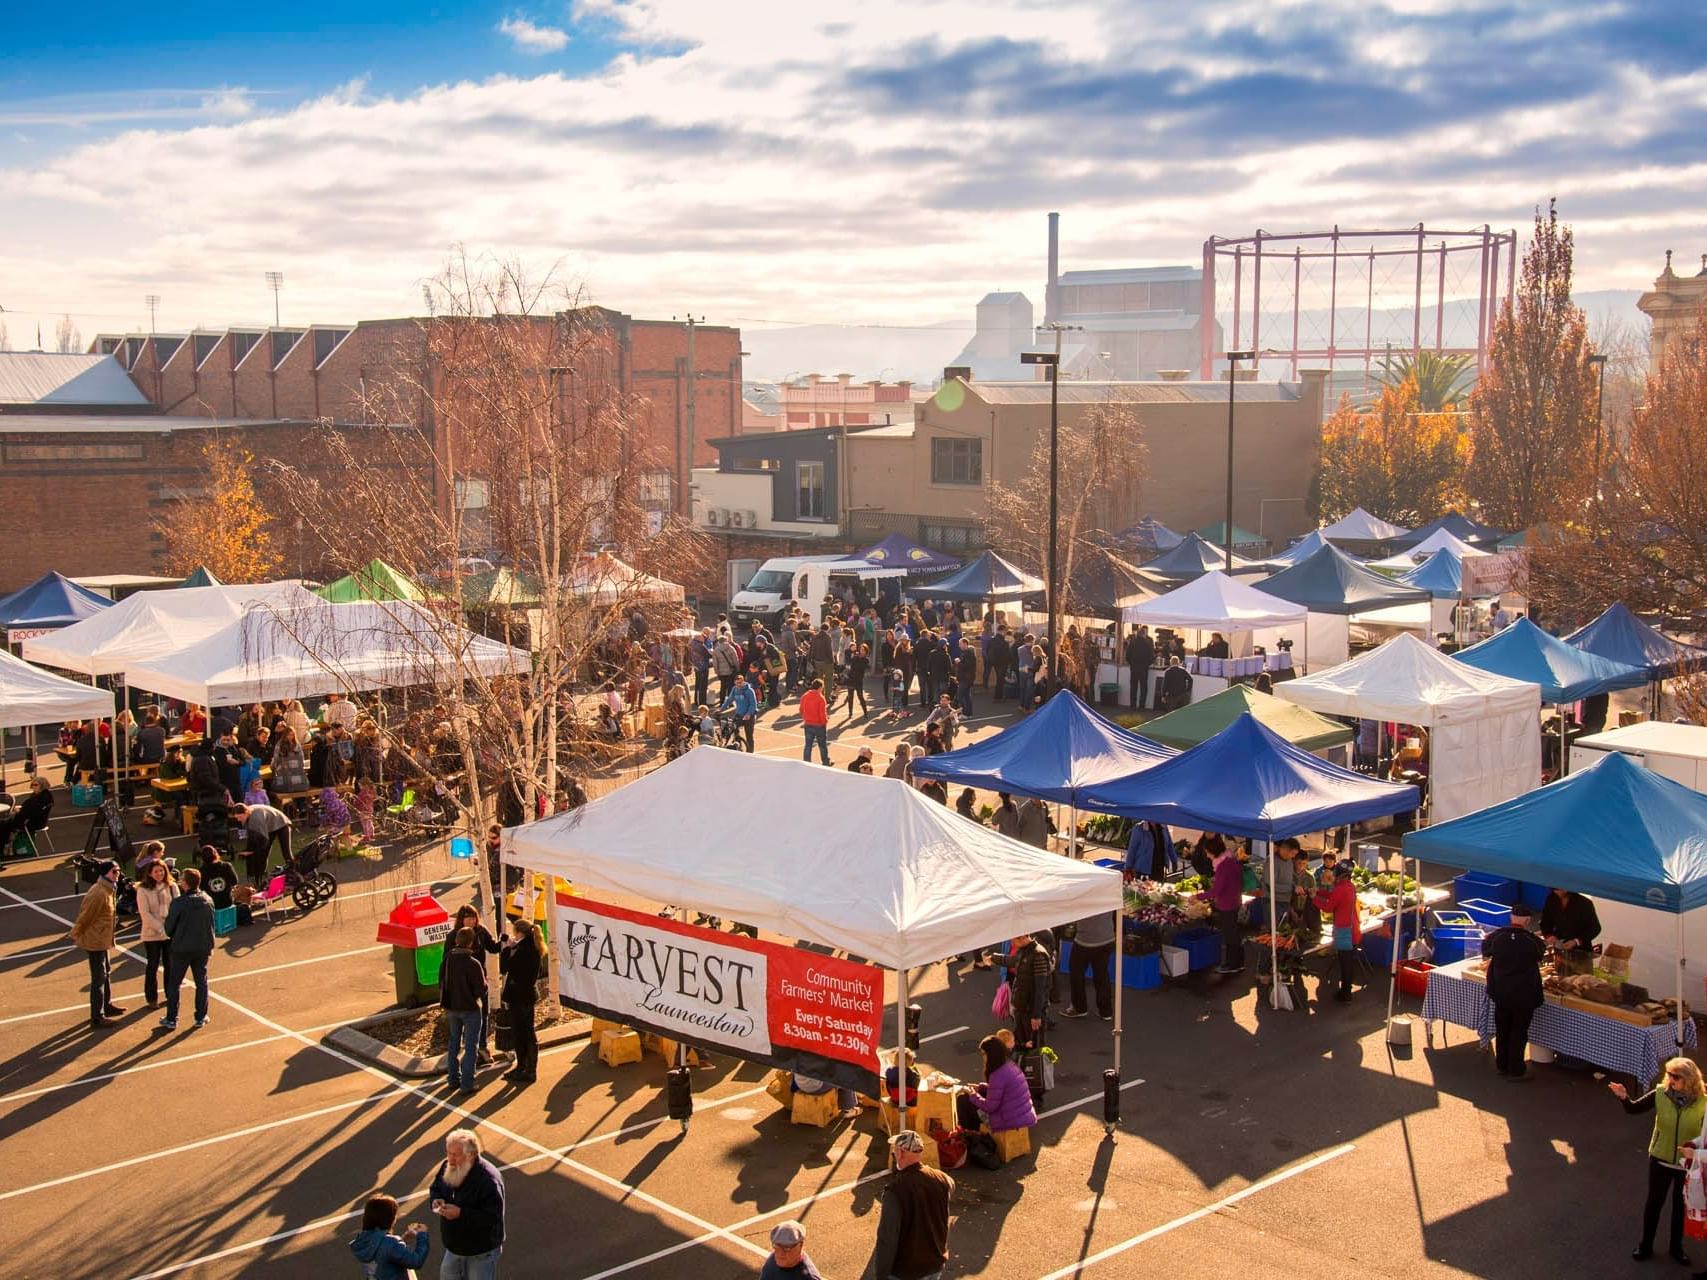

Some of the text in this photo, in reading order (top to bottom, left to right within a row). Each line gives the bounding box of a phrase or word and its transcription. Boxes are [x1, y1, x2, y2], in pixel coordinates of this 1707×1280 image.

[423, 923, 451, 936] GENERAL
[565, 919, 753, 1013] HARVEST
[781, 979, 874, 1014] Farmers' Market
[806, 967, 872, 999] Community
[635, 984, 755, 1038] Launceston
[795, 1007, 873, 1040] Every Saturday
[783, 1022, 823, 1042] 8.30am
